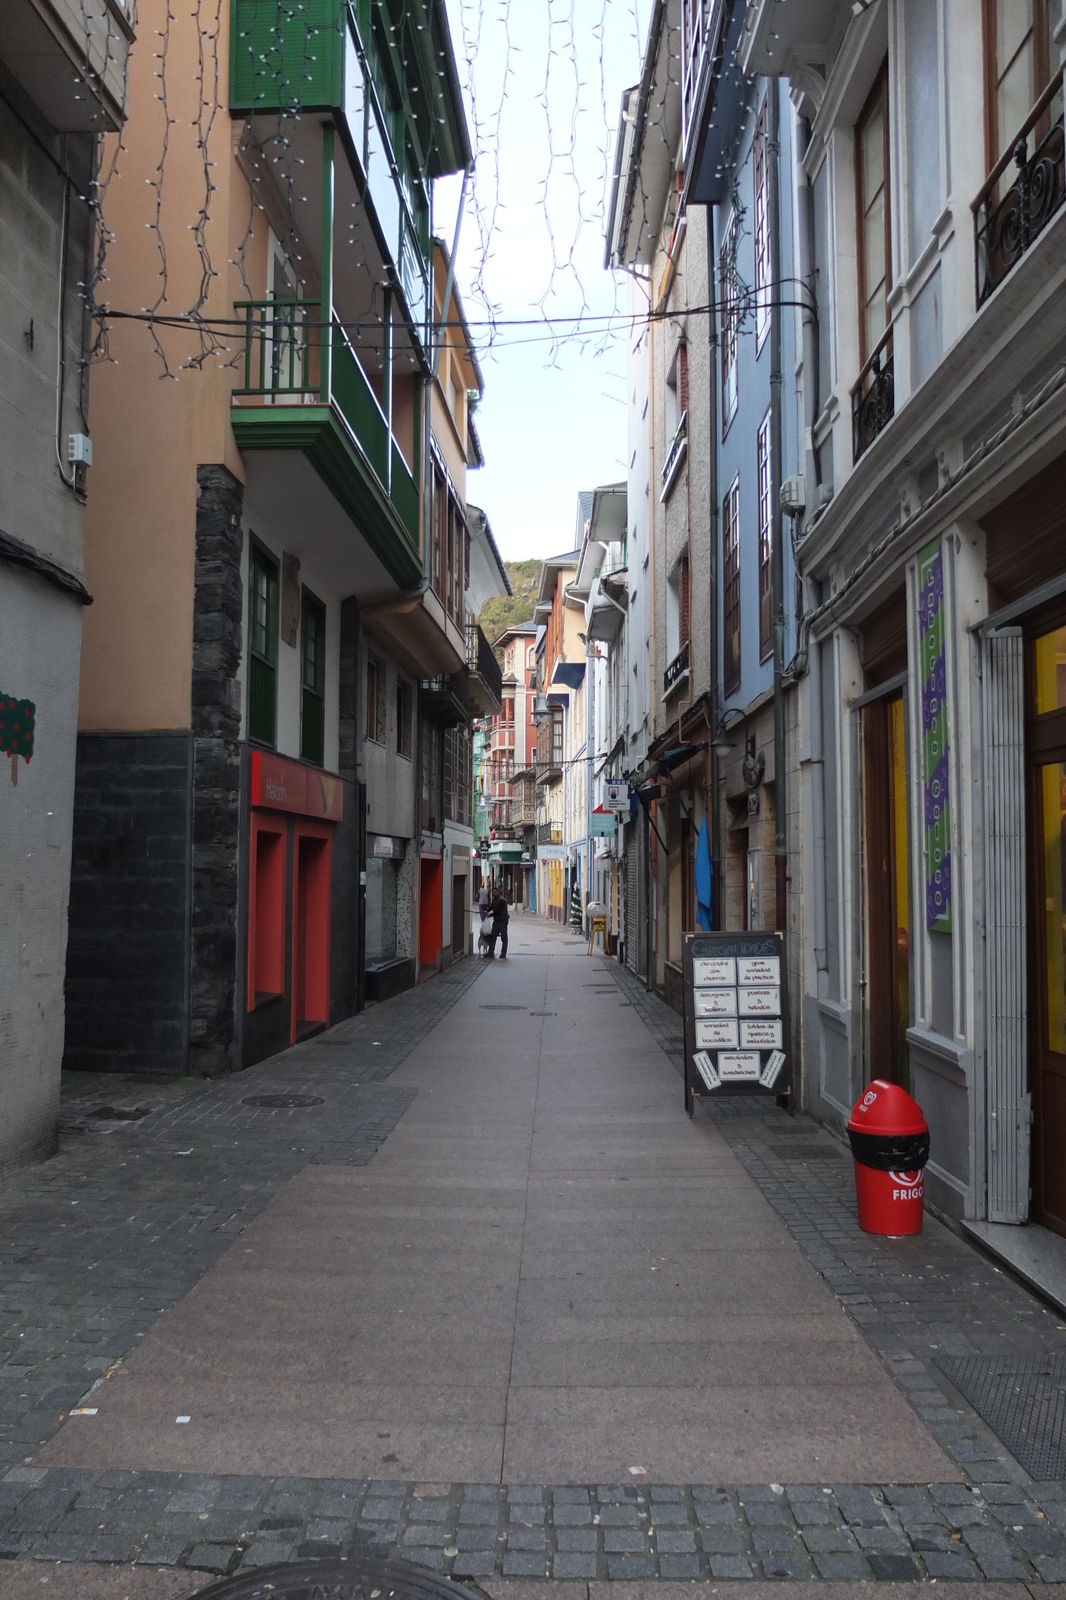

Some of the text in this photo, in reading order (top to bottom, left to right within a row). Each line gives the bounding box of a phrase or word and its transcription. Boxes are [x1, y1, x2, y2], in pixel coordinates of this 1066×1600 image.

[926, 568, 938, 756] Laberinto
[931, 779, 942, 906] Goloso
[892, 1186, 923, 1200] FRIGO
